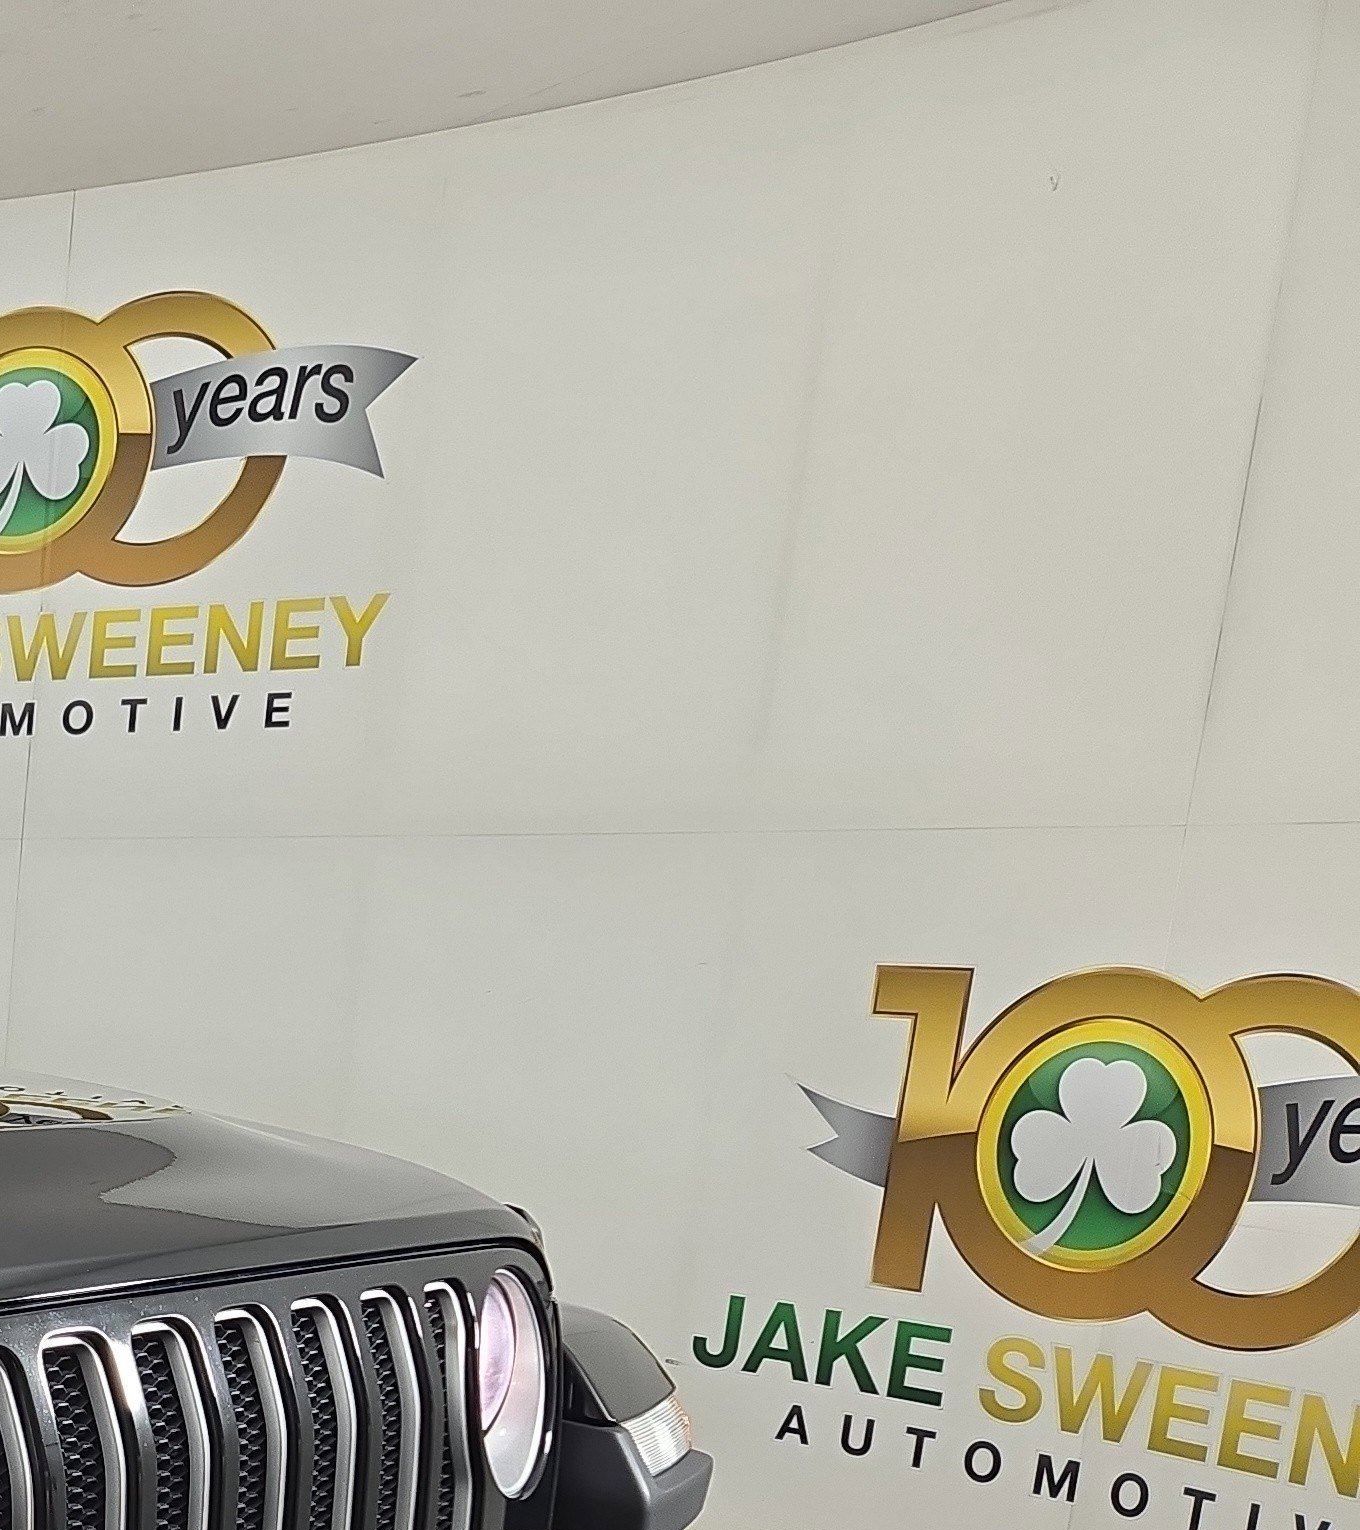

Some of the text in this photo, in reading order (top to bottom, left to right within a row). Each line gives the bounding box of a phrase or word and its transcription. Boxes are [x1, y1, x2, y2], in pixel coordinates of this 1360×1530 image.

[167, 358, 355, 457] years
[692, 1293, 1360, 1500] JAKE SWEEN
